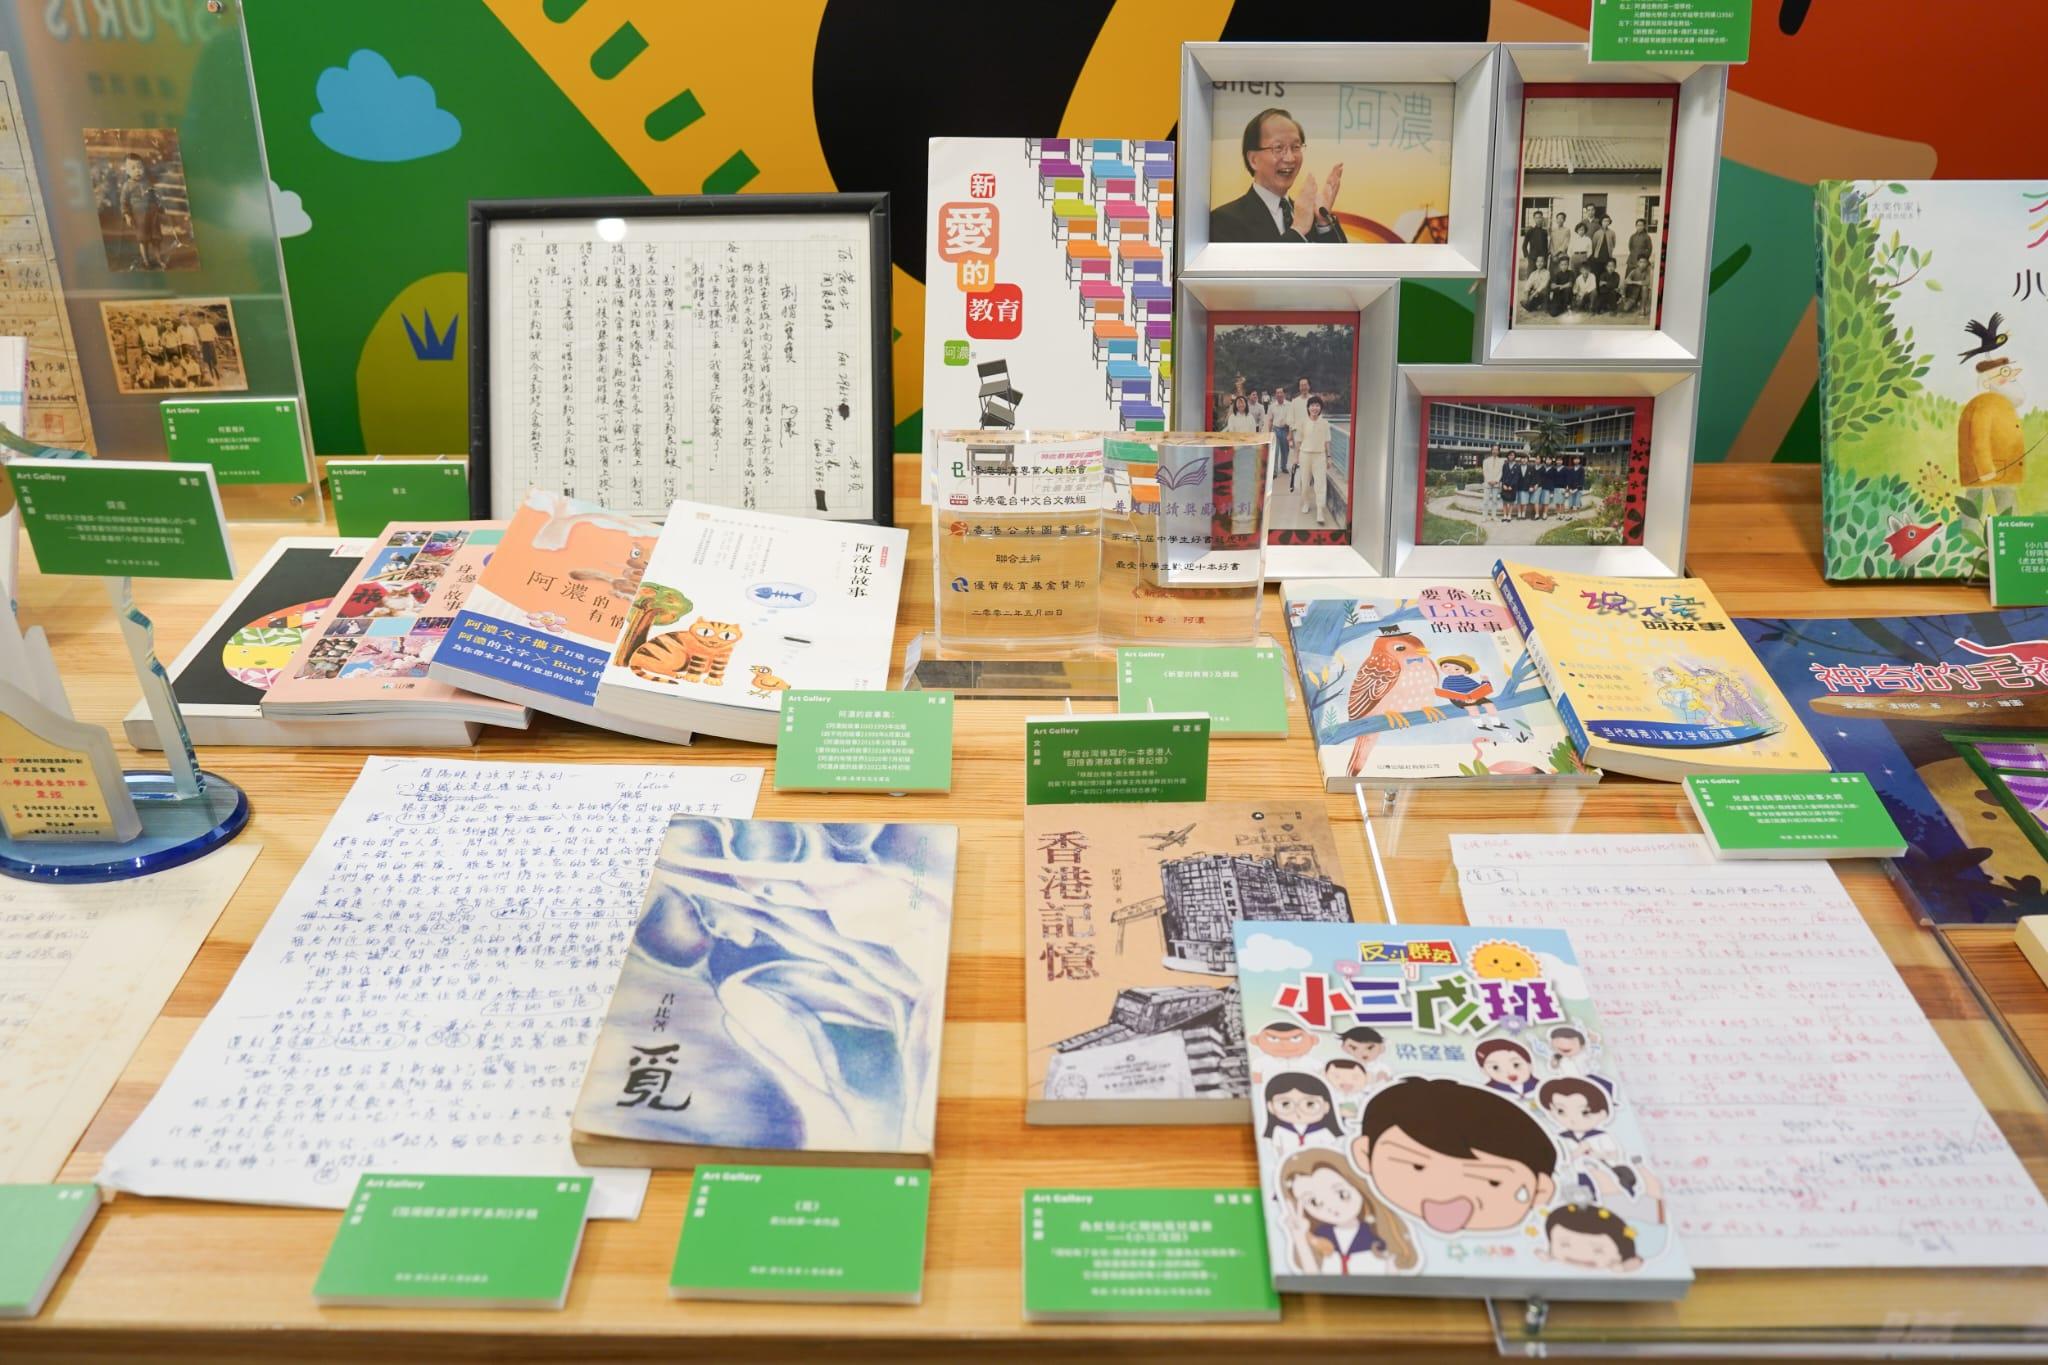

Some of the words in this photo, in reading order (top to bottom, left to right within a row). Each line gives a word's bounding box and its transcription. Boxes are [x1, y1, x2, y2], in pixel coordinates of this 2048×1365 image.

[1337, 84, 1433, 153] 阿濃
[972, 174, 995, 197] 新
[945, 206, 993, 255] 愛
[962, 259, 990, 286] 的
[968, 298, 1020, 323] 教育
[944, 345, 969, 359] 阿濃
[16, 472, 30, 480] Art
[32, 472, 66, 482] Gallery
[1421, 588, 1493, 602] 要你給
[1428, 602, 1495, 619] Like
[1430, 620, 1503, 634] 的故事
[1641, 619, 1727, 632] 的故事
[552, 659, 589, 678] Birdy
[1036, 831, 1100, 981] 香港記憶
[1223, 880, 1238, 917] KENT
[365, 1179, 384, 1188] Art
[386, 1180, 425, 1190] Gallery
[702, 1172, 720, 1181] Art
[722, 1172, 762, 1183] Gallery
[1033, 1194, 1051, 1203] Art
[1053, 1194, 1093, 1205] Gallery
